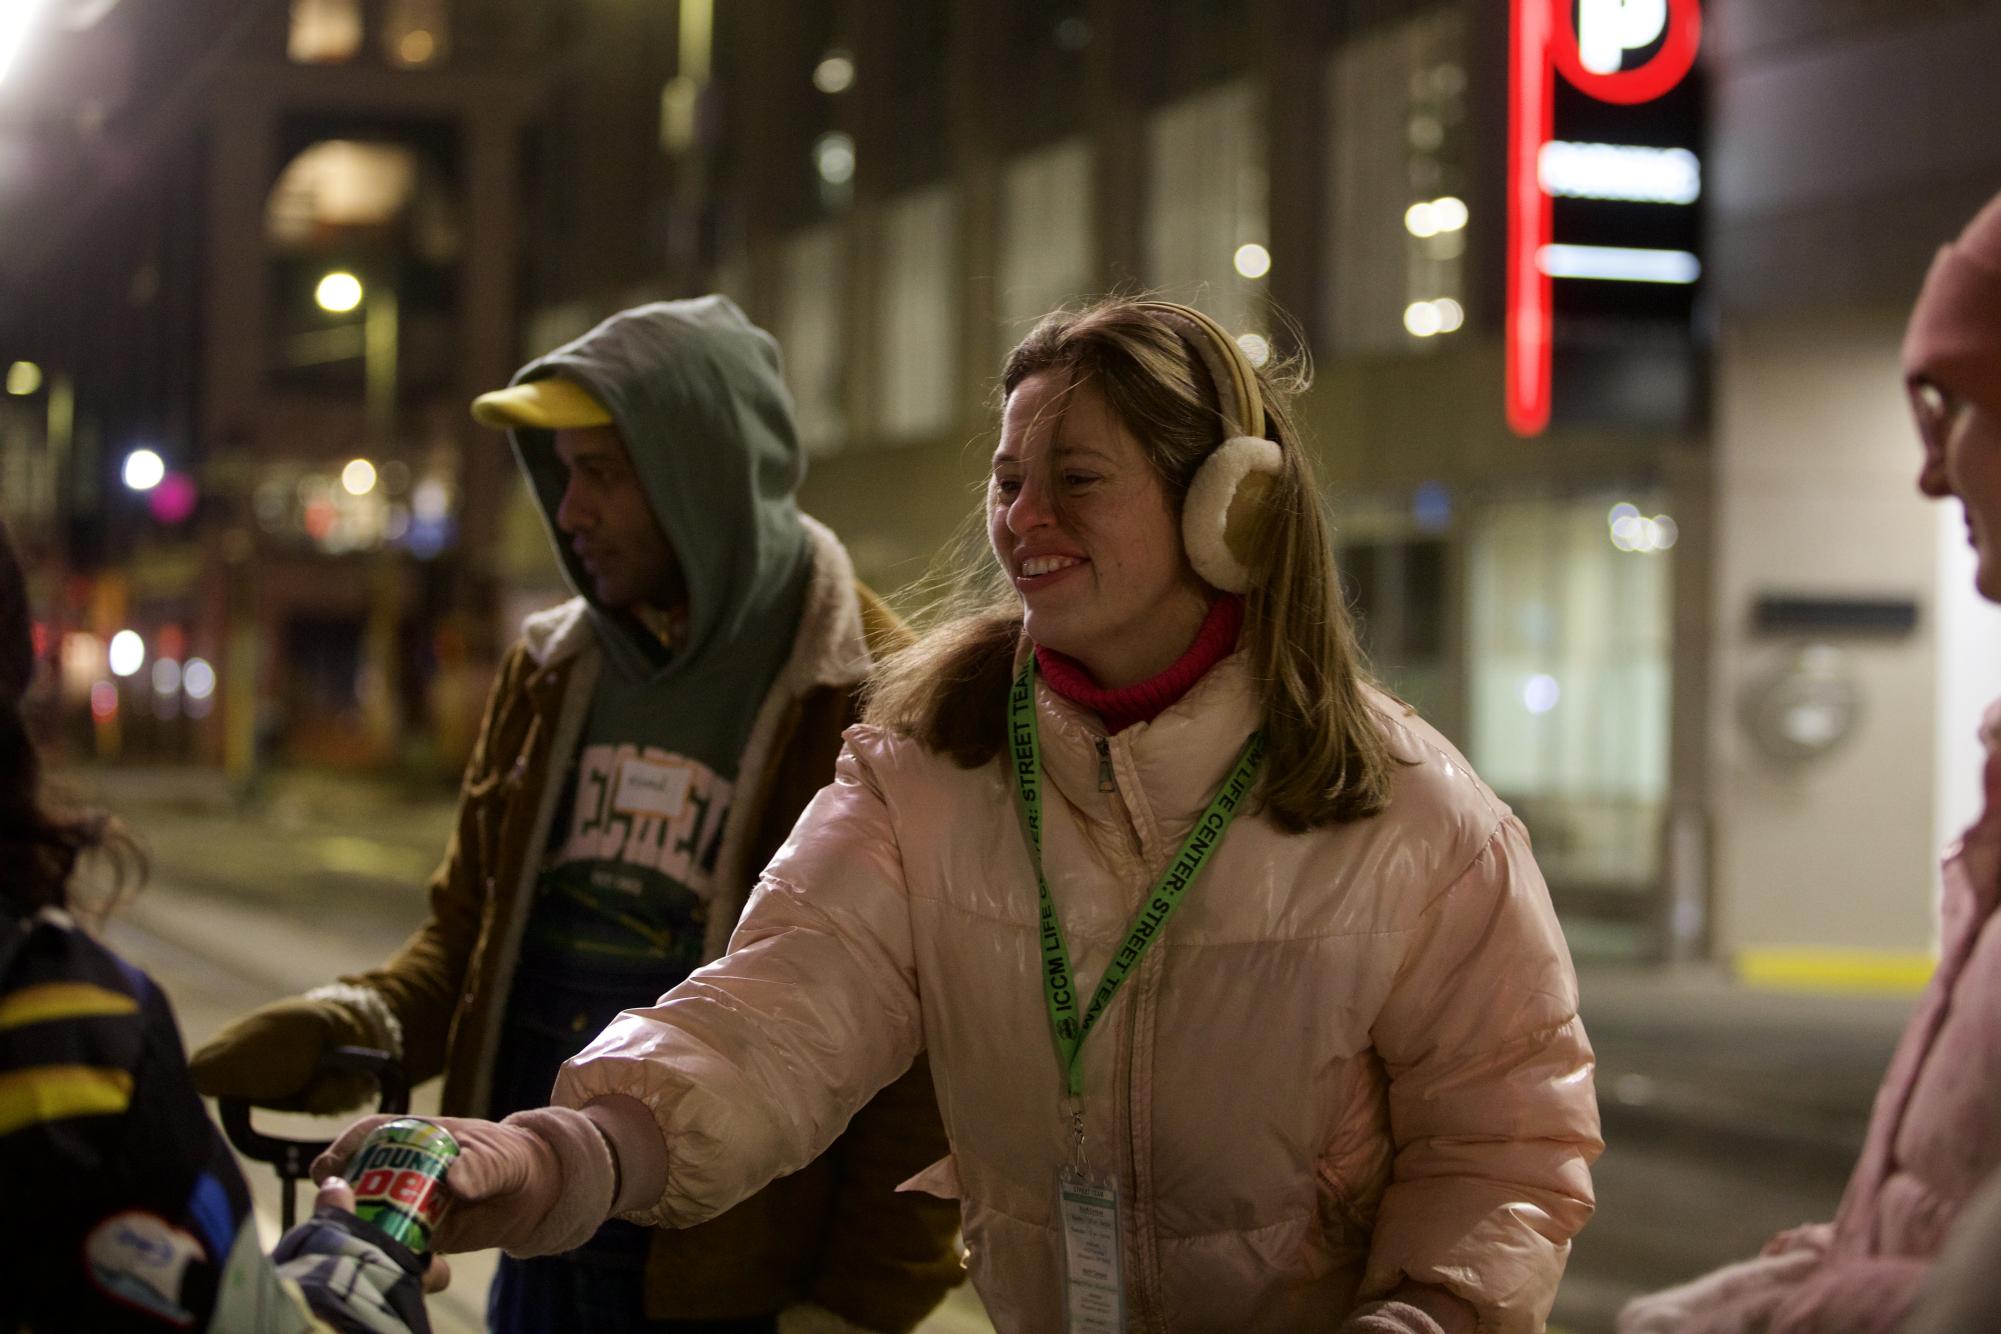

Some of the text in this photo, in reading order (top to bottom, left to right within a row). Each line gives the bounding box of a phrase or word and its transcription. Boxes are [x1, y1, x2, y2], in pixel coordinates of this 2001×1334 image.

[1013, 721, 1037, 802] STREET
[1218, 768, 1250, 812] LIFE
[1162, 813, 1224, 895] CENTER:
[1042, 904, 1060, 952] LIFE
[1115, 896, 1170, 974] STREET
[1053, 957, 1073, 1012] ICCM
[1082, 976, 1120, 1030] TEAM
